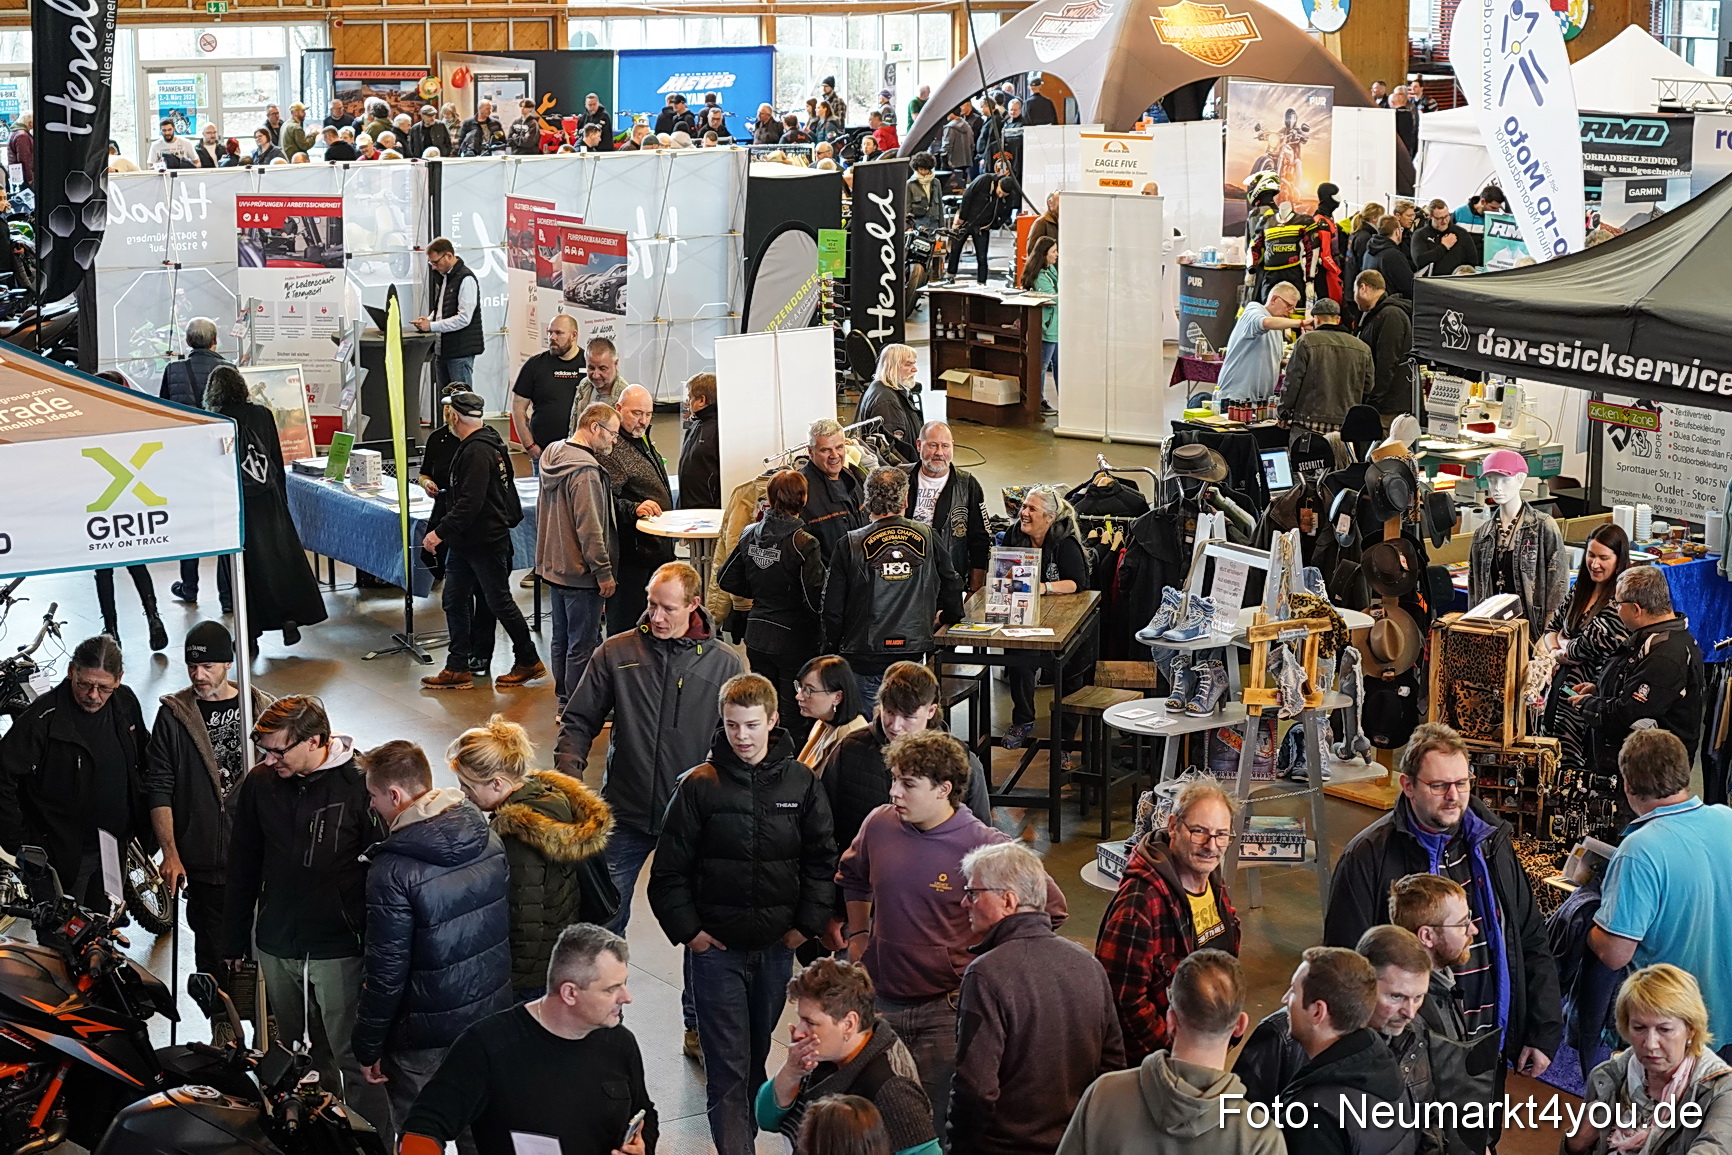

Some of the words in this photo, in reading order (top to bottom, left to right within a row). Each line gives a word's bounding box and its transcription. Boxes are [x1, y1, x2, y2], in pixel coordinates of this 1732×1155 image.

[104, 32, 114, 53] aus
[44, 0, 99, 141] Herol
[101, 54, 113, 86] Alles
[657, 75, 737, 94] MEYER
[1309, 97, 1327, 107] PUR
[1582, 122, 1664, 142] RMD
[1094, 159, 1118, 167] EAGLE
[1120, 160, 1138, 169] FIVE
[1628, 187, 1663, 197] GARMIN
[289, 201, 341, 209] ARBEITSSICHERHEIT
[1489, 220, 1524, 240] RM
[567, 233, 618, 247] FUHRPARKMANAGEMENT
[865, 188, 896, 343] Herold
[1187, 276, 1203, 287] PUR
[1477, 328, 1732, 396] dax-stickservice
[46, 409, 83, 423] ideas
[1632, 413, 1654, 426] Zone
[1674, 407, 1713, 421] Textilvertrieb
[1673, 419, 1726, 437] Berufsbekleidung
[1691, 434, 1721, 446] Collection
[1672, 442, 1695, 454] Scippis
[1695, 446, 1725, 459] Australian
[1299, 459, 1325, 471] SECURITY
[1672, 453, 1728, 473] Outdoorbekleidung
[1616, 462, 1658, 477] Sprottauer
[1659, 468, 1671, 479] Str.
[1673, 471, 1682, 480] 12
[1694, 475, 1718, 488] 90475
[1655, 482, 1685, 497] Outlet
[1692, 490, 1717, 504] Store
[1694, 502, 1706, 511] Uhr
[86, 510, 169, 541] GRIP
[897, 529, 921, 542] CHAPTER
[88, 541, 114, 551] STAY
[117, 539, 133, 548] ON
[136, 536, 170, 546] TRACK
[883, 562, 911, 575] HOG
